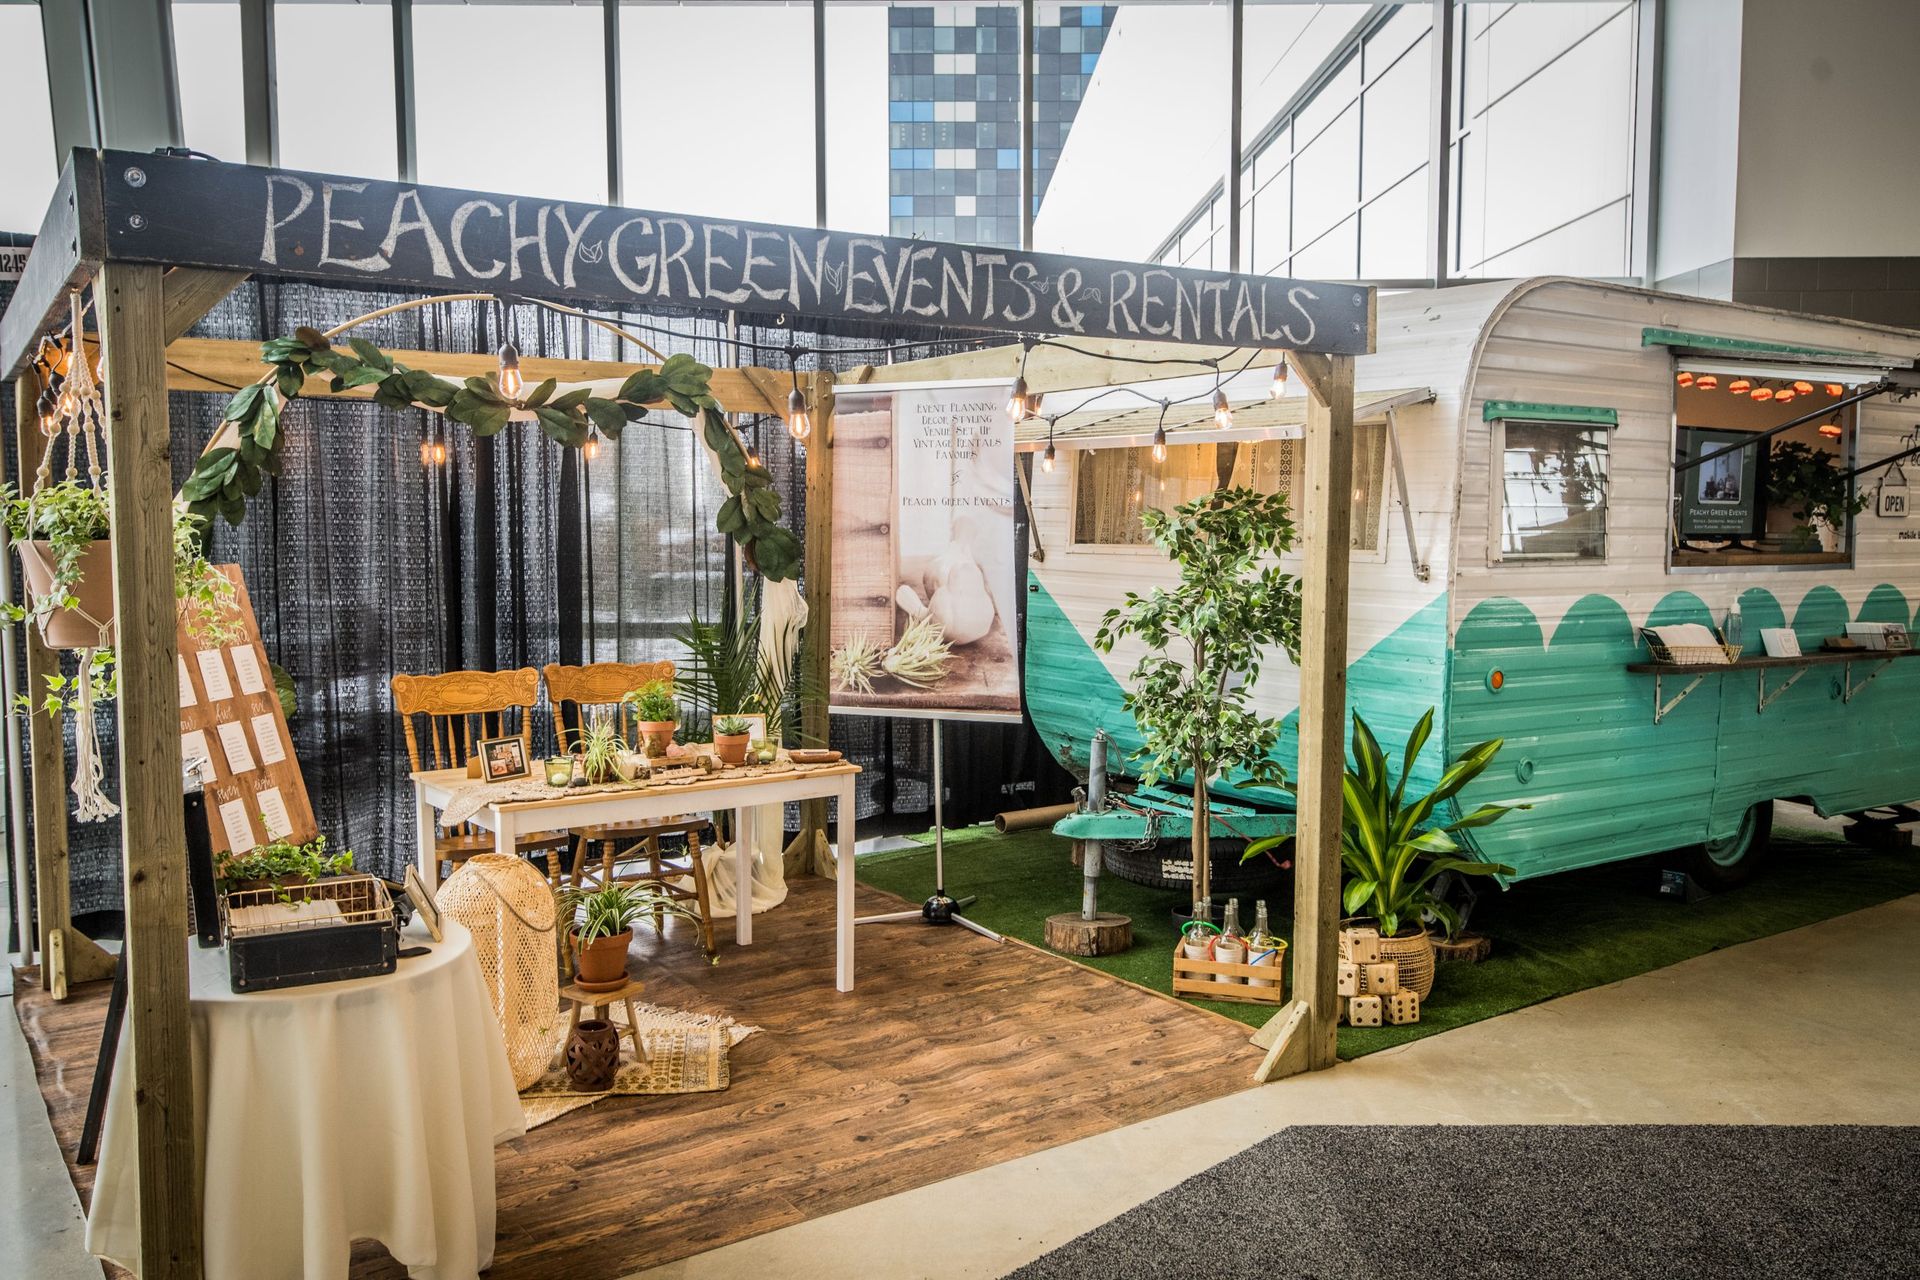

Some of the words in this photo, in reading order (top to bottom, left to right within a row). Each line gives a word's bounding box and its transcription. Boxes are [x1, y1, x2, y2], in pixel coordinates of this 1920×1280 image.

[260, 174, 602, 289] PEACHY
[608, 217, 831, 312] GREEN
[843, 238, 1037, 322] EVENTS
[1051, 267, 1085, 333] &
[1106, 269, 1320, 345] RENTALS
[1885, 496, 1904, 512] OPEN
